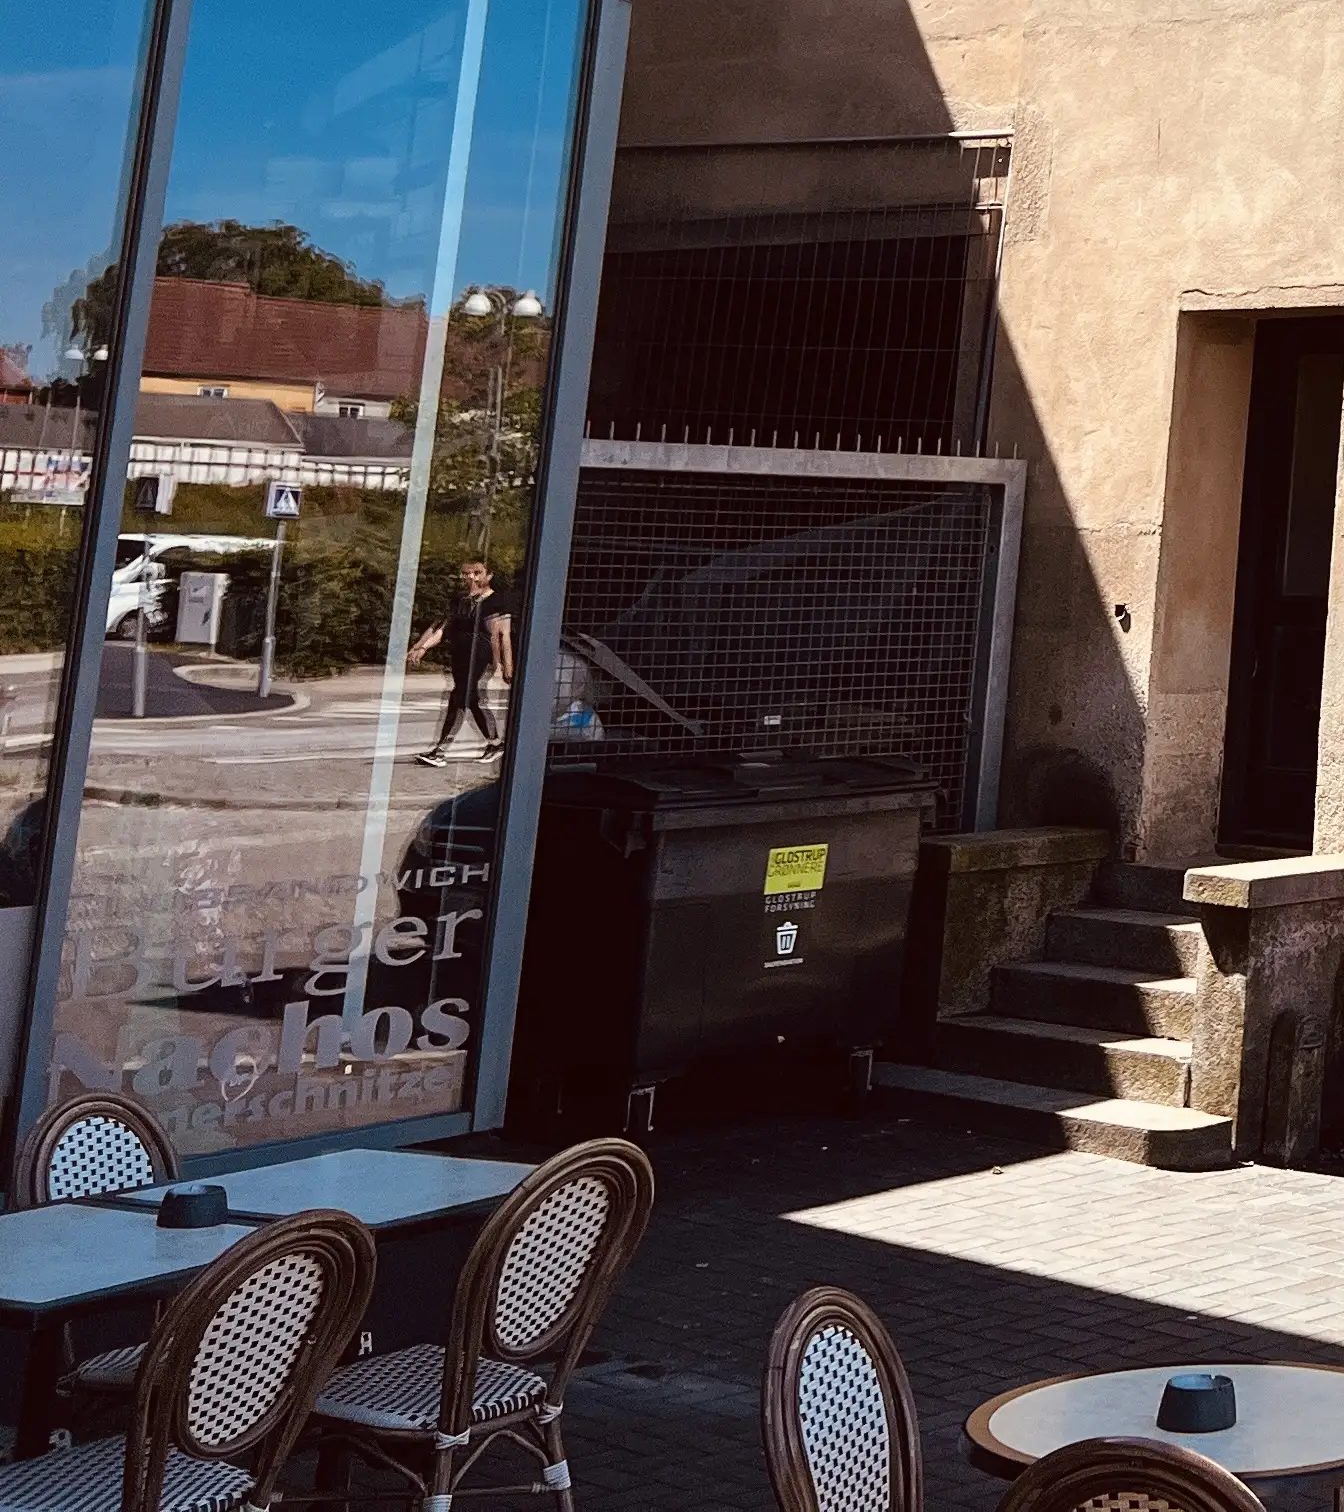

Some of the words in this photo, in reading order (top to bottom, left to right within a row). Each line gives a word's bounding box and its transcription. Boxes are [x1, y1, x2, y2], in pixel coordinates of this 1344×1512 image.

[774, 847, 826, 865] GLOSTRUP
[765, 891, 817, 904] GLOSTRUP
[69, 906, 484, 1002] Burger
[50, 997, 471, 1103] Nachos
